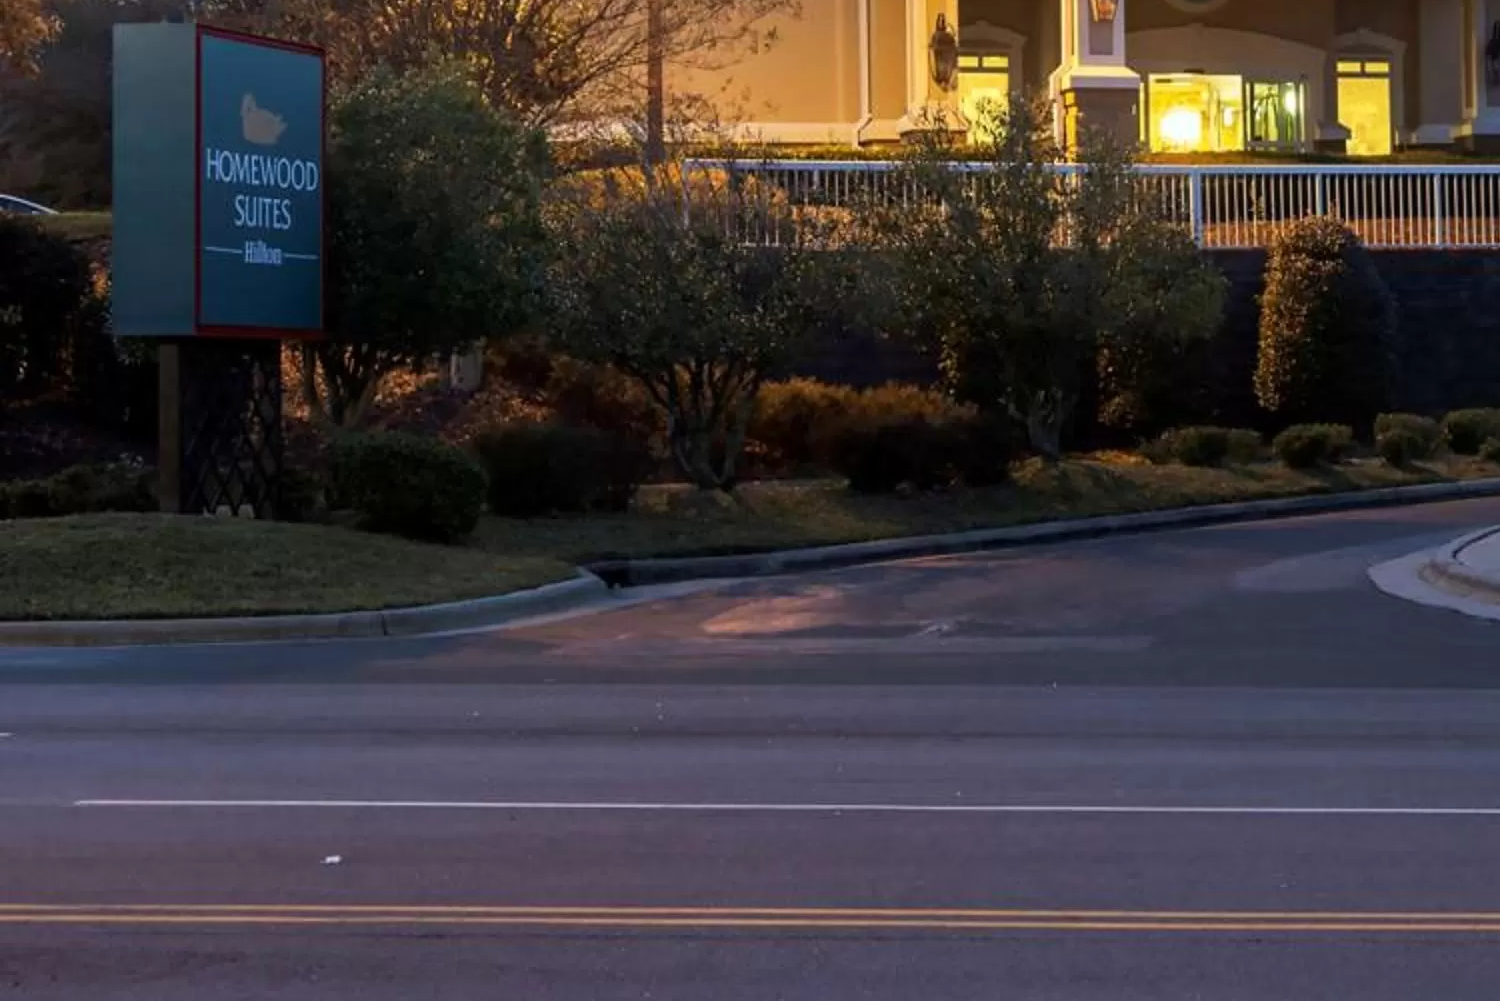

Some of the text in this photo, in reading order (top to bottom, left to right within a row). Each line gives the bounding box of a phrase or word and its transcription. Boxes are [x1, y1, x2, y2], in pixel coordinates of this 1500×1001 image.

[206, 148, 319, 191] HOMEWOOD
[234, 194, 291, 230] SUITES
[245, 240, 282, 264] Hilton
